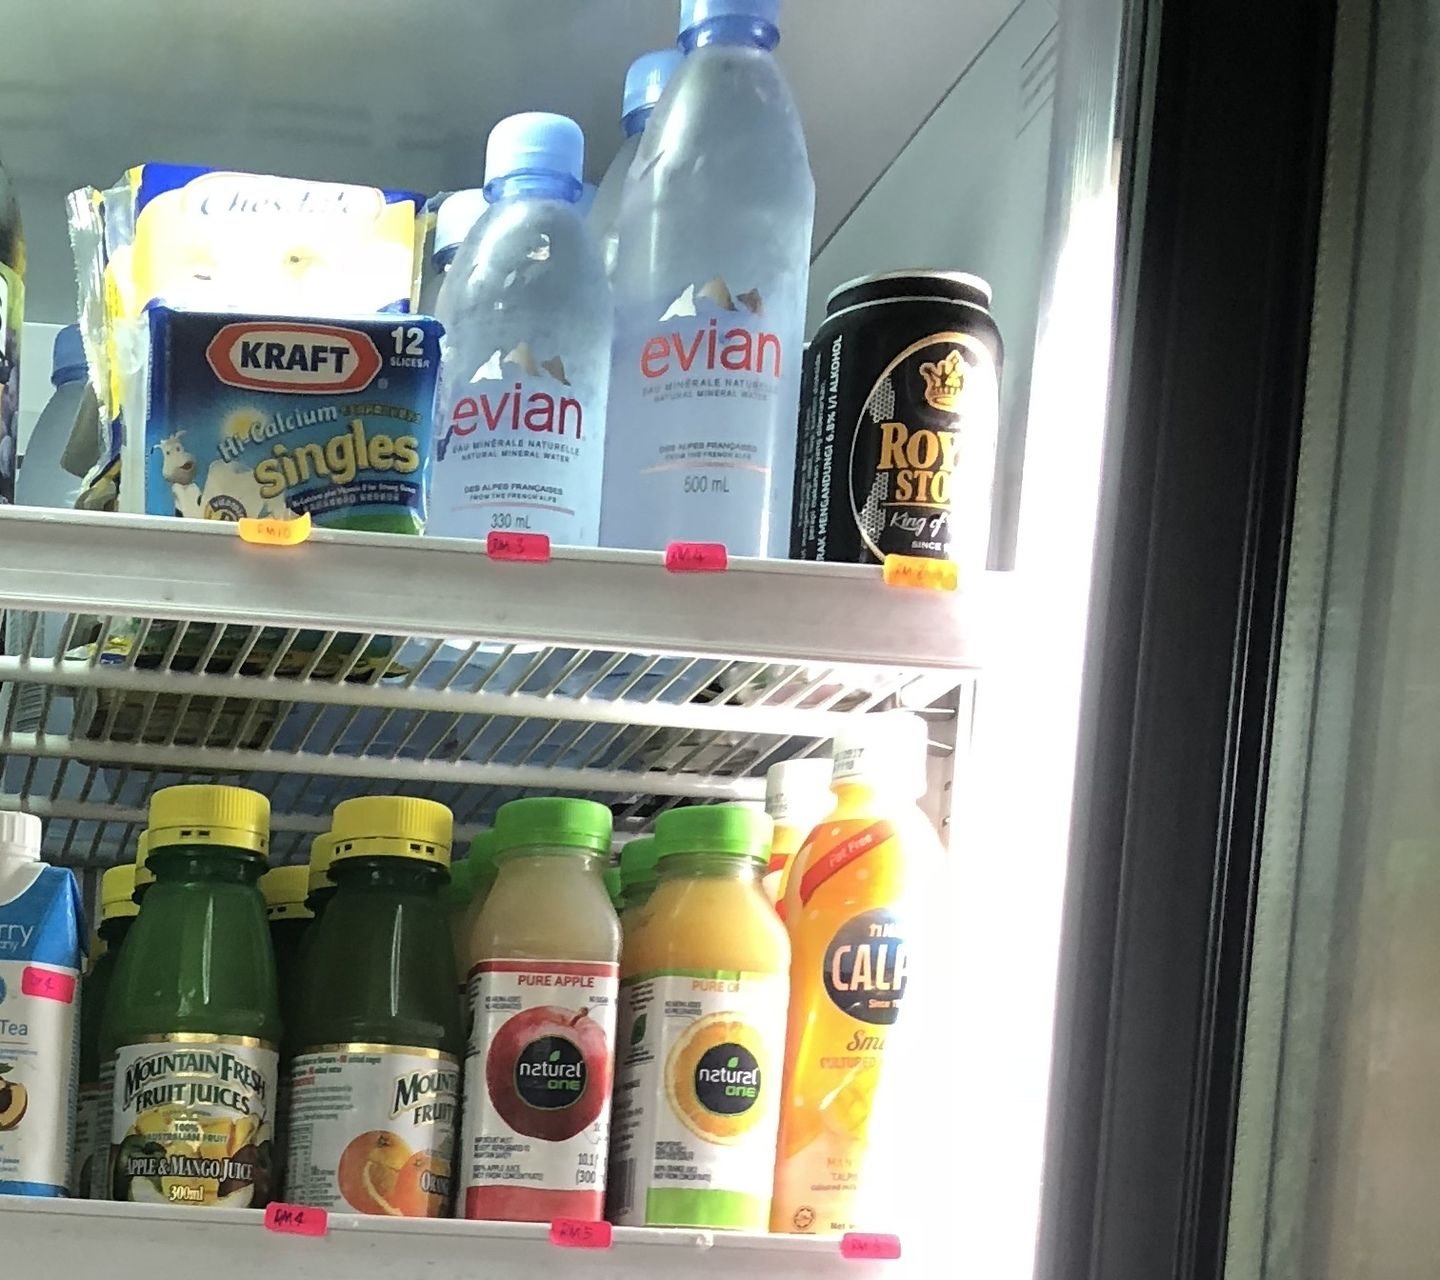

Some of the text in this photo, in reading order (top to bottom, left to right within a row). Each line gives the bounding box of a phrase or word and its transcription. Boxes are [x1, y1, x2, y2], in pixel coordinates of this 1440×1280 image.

[240, 326, 424, 373] KRAFT 12
[640, 319, 782, 379] evian
[452, 383, 583, 439] evian
[218, 402, 338, 463] Hi-Calcium
[818, 335, 843, 537] MENGANDUNGI ALKOHOL
[528, 439, 580, 457] NATURELLE
[254, 420, 420, 500] singles
[712, 476, 730, 493] mL
[491, 513, 531, 529] 330 mL
[518, 974, 594, 989] PURE APPLE
[692, 980, 724, 993] PURE
[519, 1062, 582, 1079] natural
[699, 1067, 759, 1086] natural
[136, 1084, 250, 1115] FRUIT JUICES
[169, 1185, 204, 1202] 300ml
